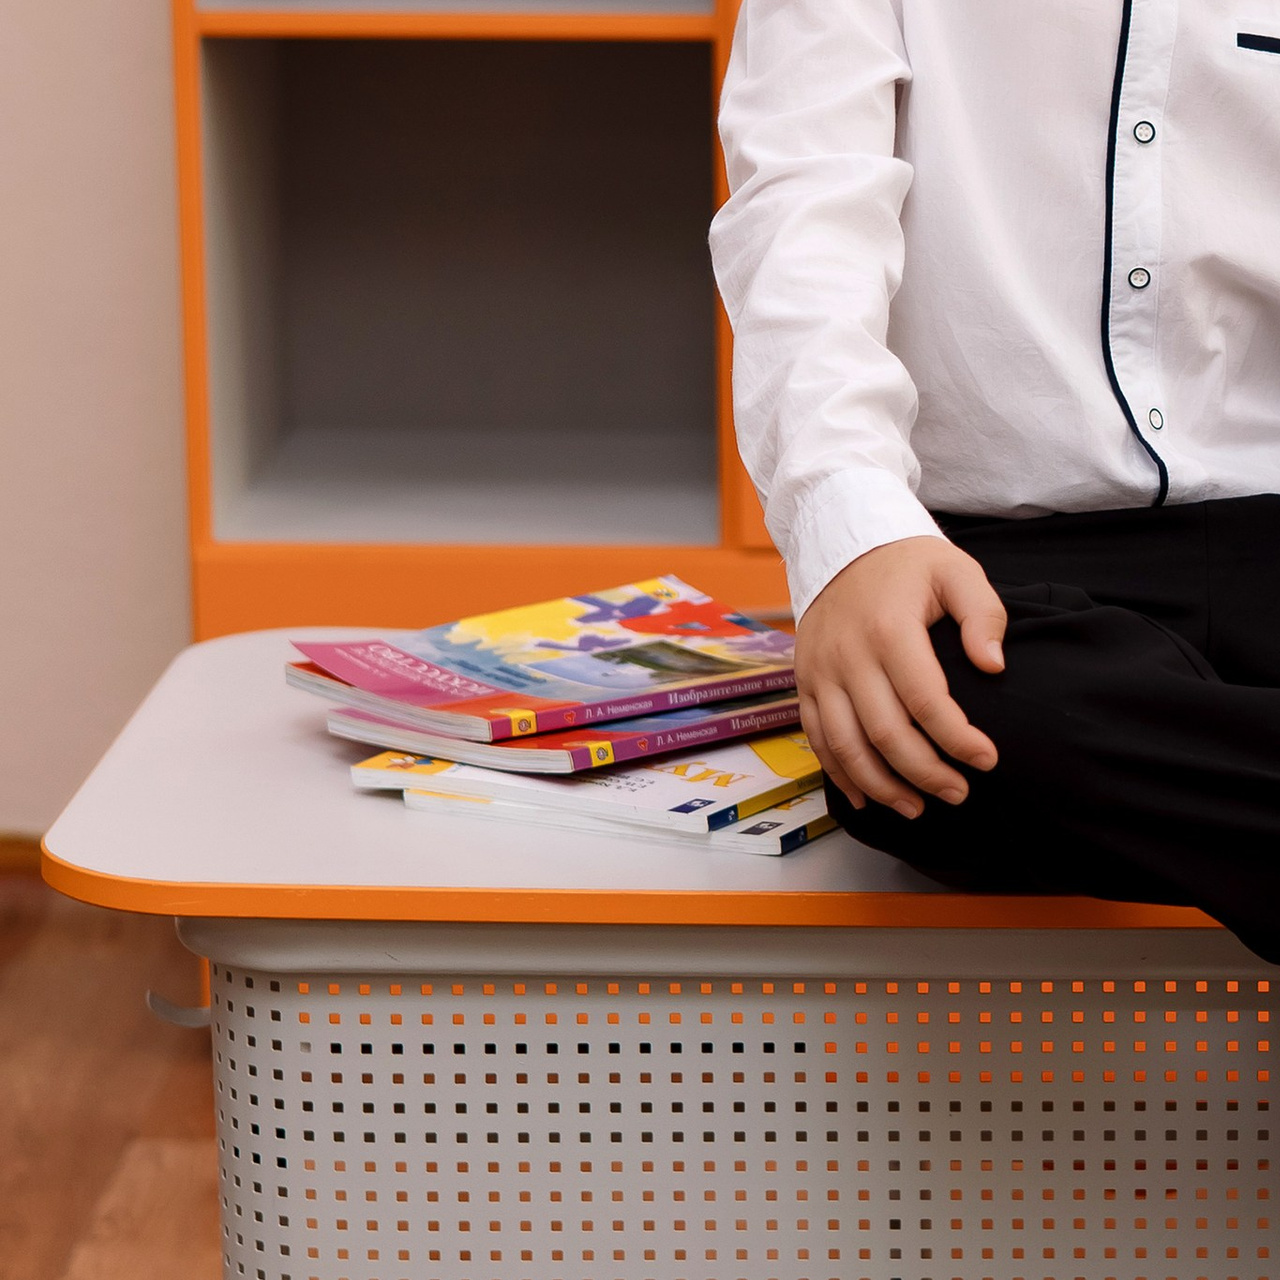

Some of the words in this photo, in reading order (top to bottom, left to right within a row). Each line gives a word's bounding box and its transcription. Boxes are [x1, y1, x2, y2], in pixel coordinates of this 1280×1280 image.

[607, 699, 653, 716] Неменская
[667, 680, 763, 706] Изобразительное
[766, 674, 794, 689] искус
[677, 726, 718, 742] Неменская
[730, 708, 799, 731] Изобразитель
